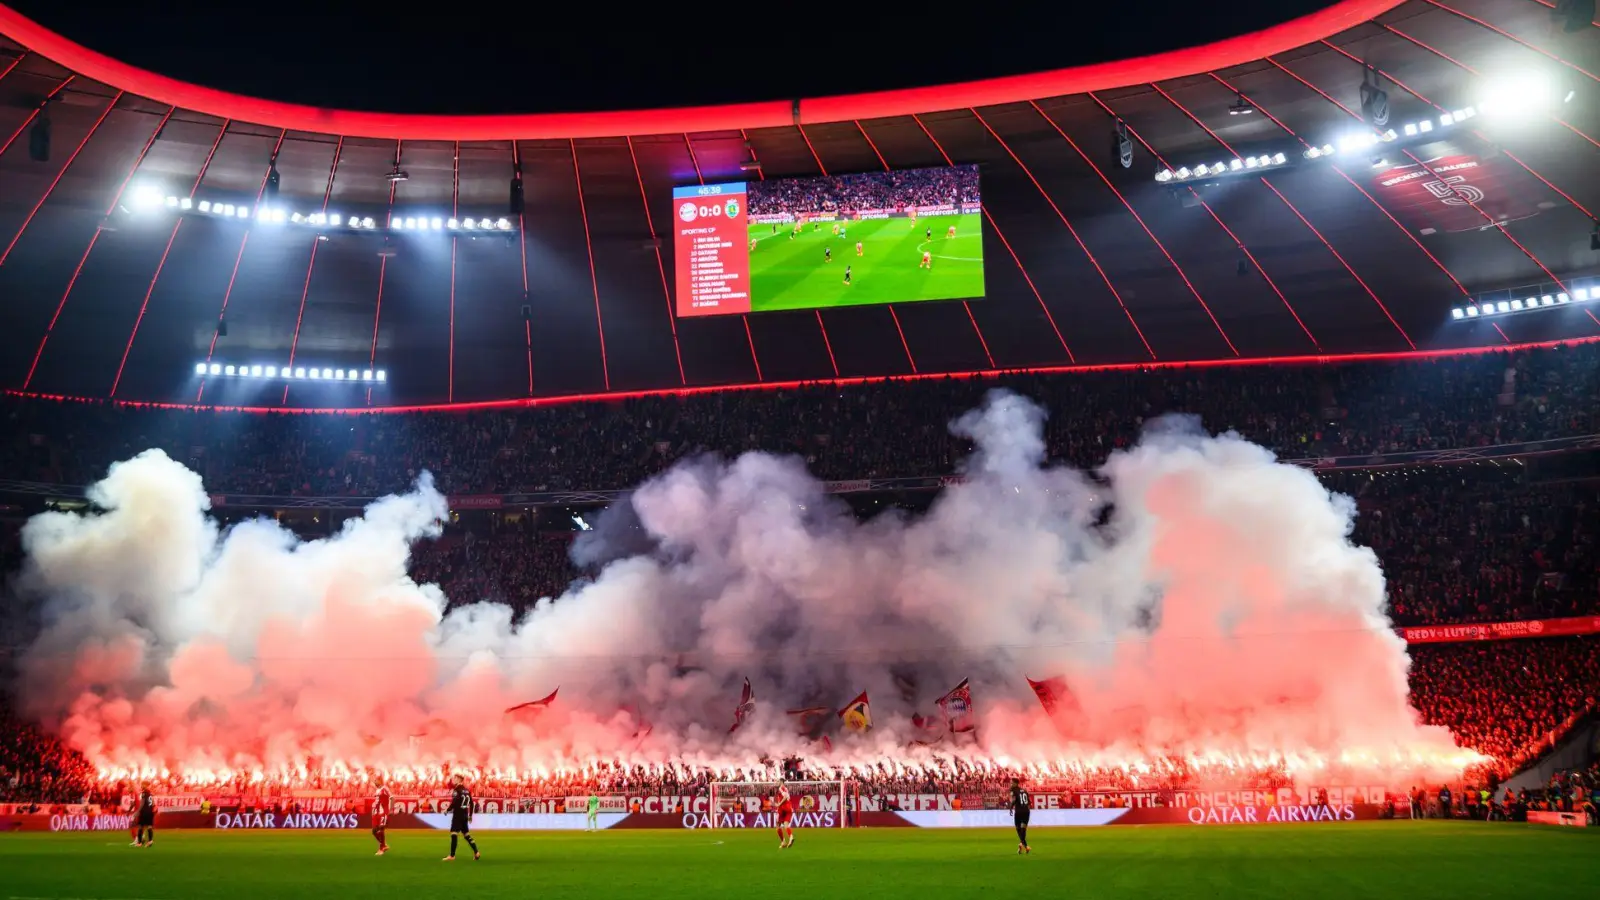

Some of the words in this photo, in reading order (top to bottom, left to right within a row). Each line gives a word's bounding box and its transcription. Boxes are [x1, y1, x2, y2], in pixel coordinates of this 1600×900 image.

[1422, 175, 1485, 205] 5
[699, 204, 722, 217] 0:0
[917, 208, 959, 216] mastercard
[1019, 787, 1028, 800] 10
[156, 795, 201, 808] BRETTEN
[460, 794, 470, 809] 22
[215, 812, 275, 828] QATAR
[283, 812, 359, 828] AIRWAYS
[682, 812, 745, 829] QATAR
[754, 812, 835, 828] AIWAYS
[1188, 806, 1257, 824] QATAR
[1266, 804, 1356, 822] AIRWAYS
[50, 814, 89, 830] QATAR
[93, 814, 134, 829] AIRWAY
